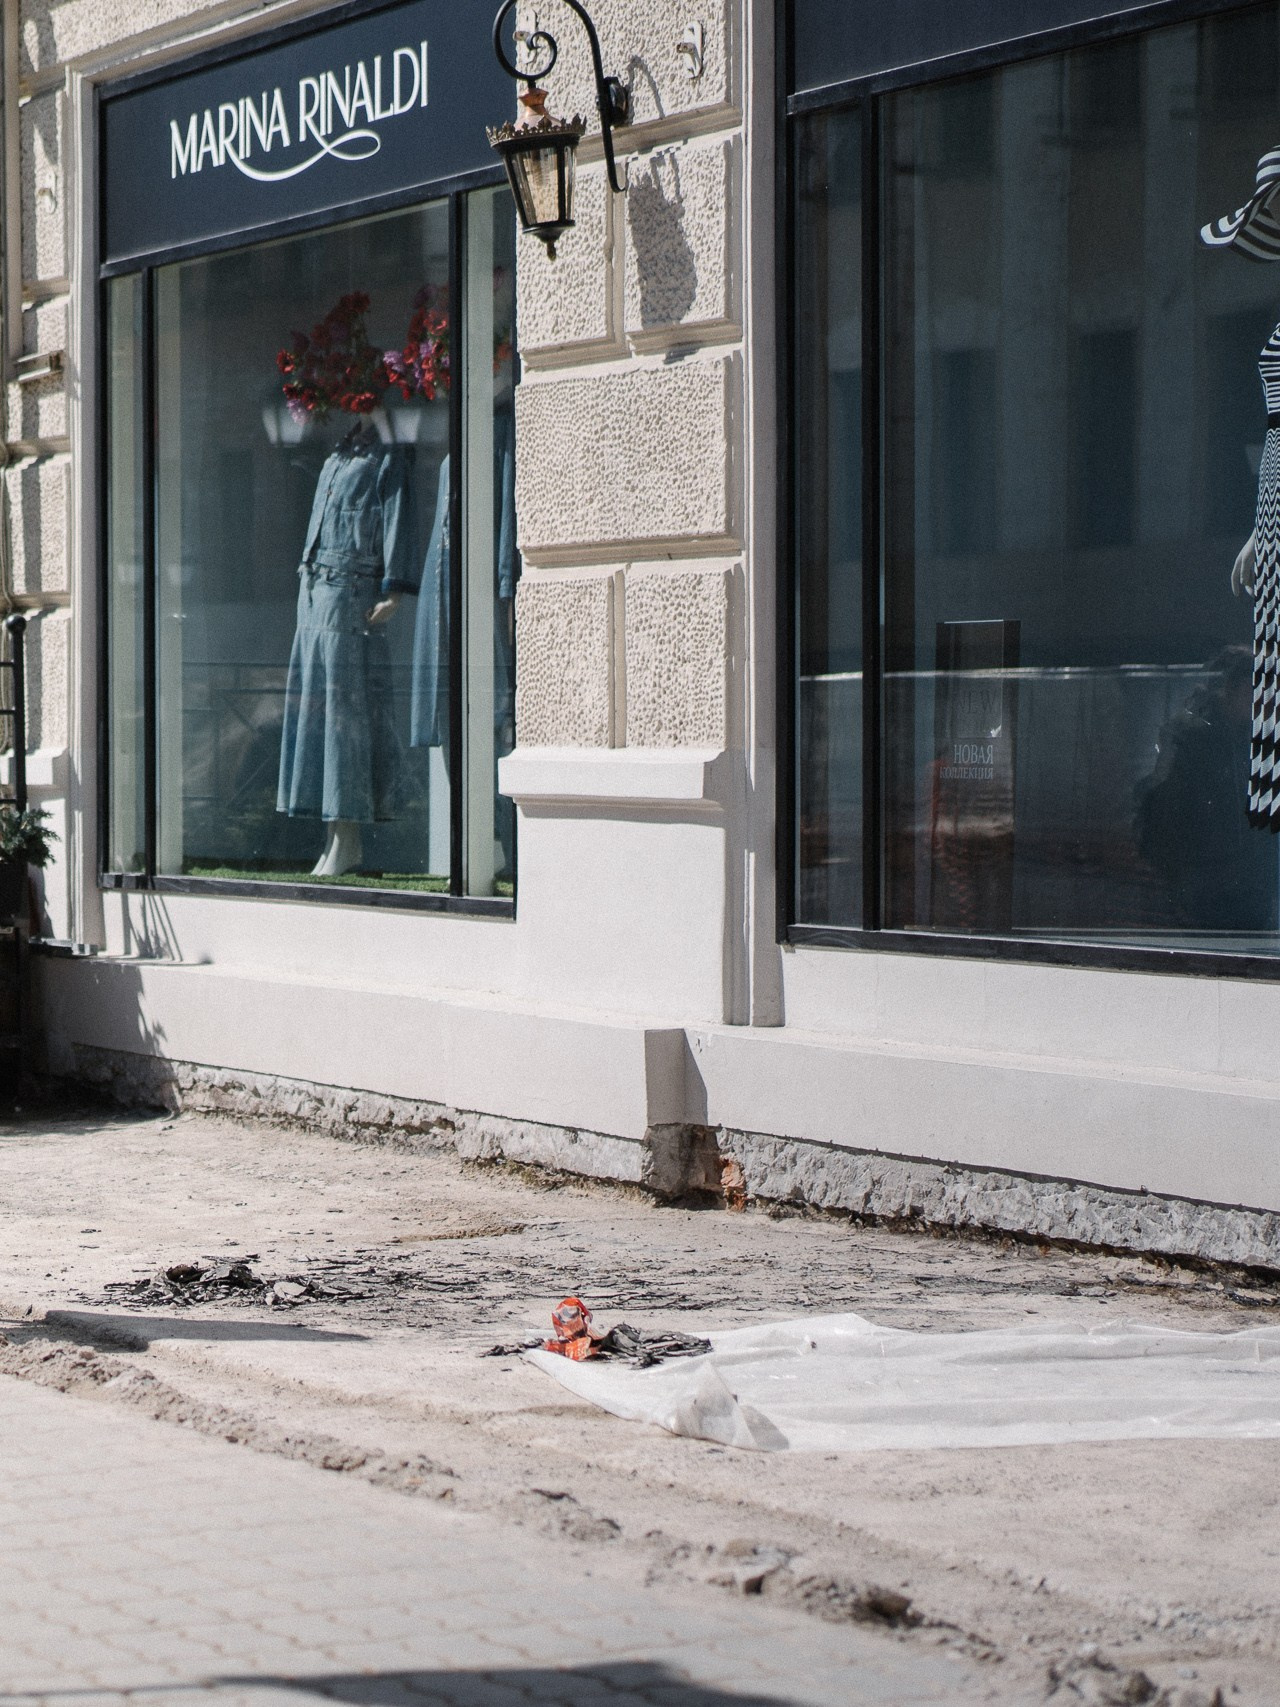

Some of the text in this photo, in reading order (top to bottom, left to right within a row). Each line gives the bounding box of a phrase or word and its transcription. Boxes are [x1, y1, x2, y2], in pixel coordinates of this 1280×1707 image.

[169, 40, 428, 181] MARINA RINALDI
[953, 744, 994, 765] НОВАЯ
[939, 766, 994, 780] КОЛЛЕКЦИЯ
